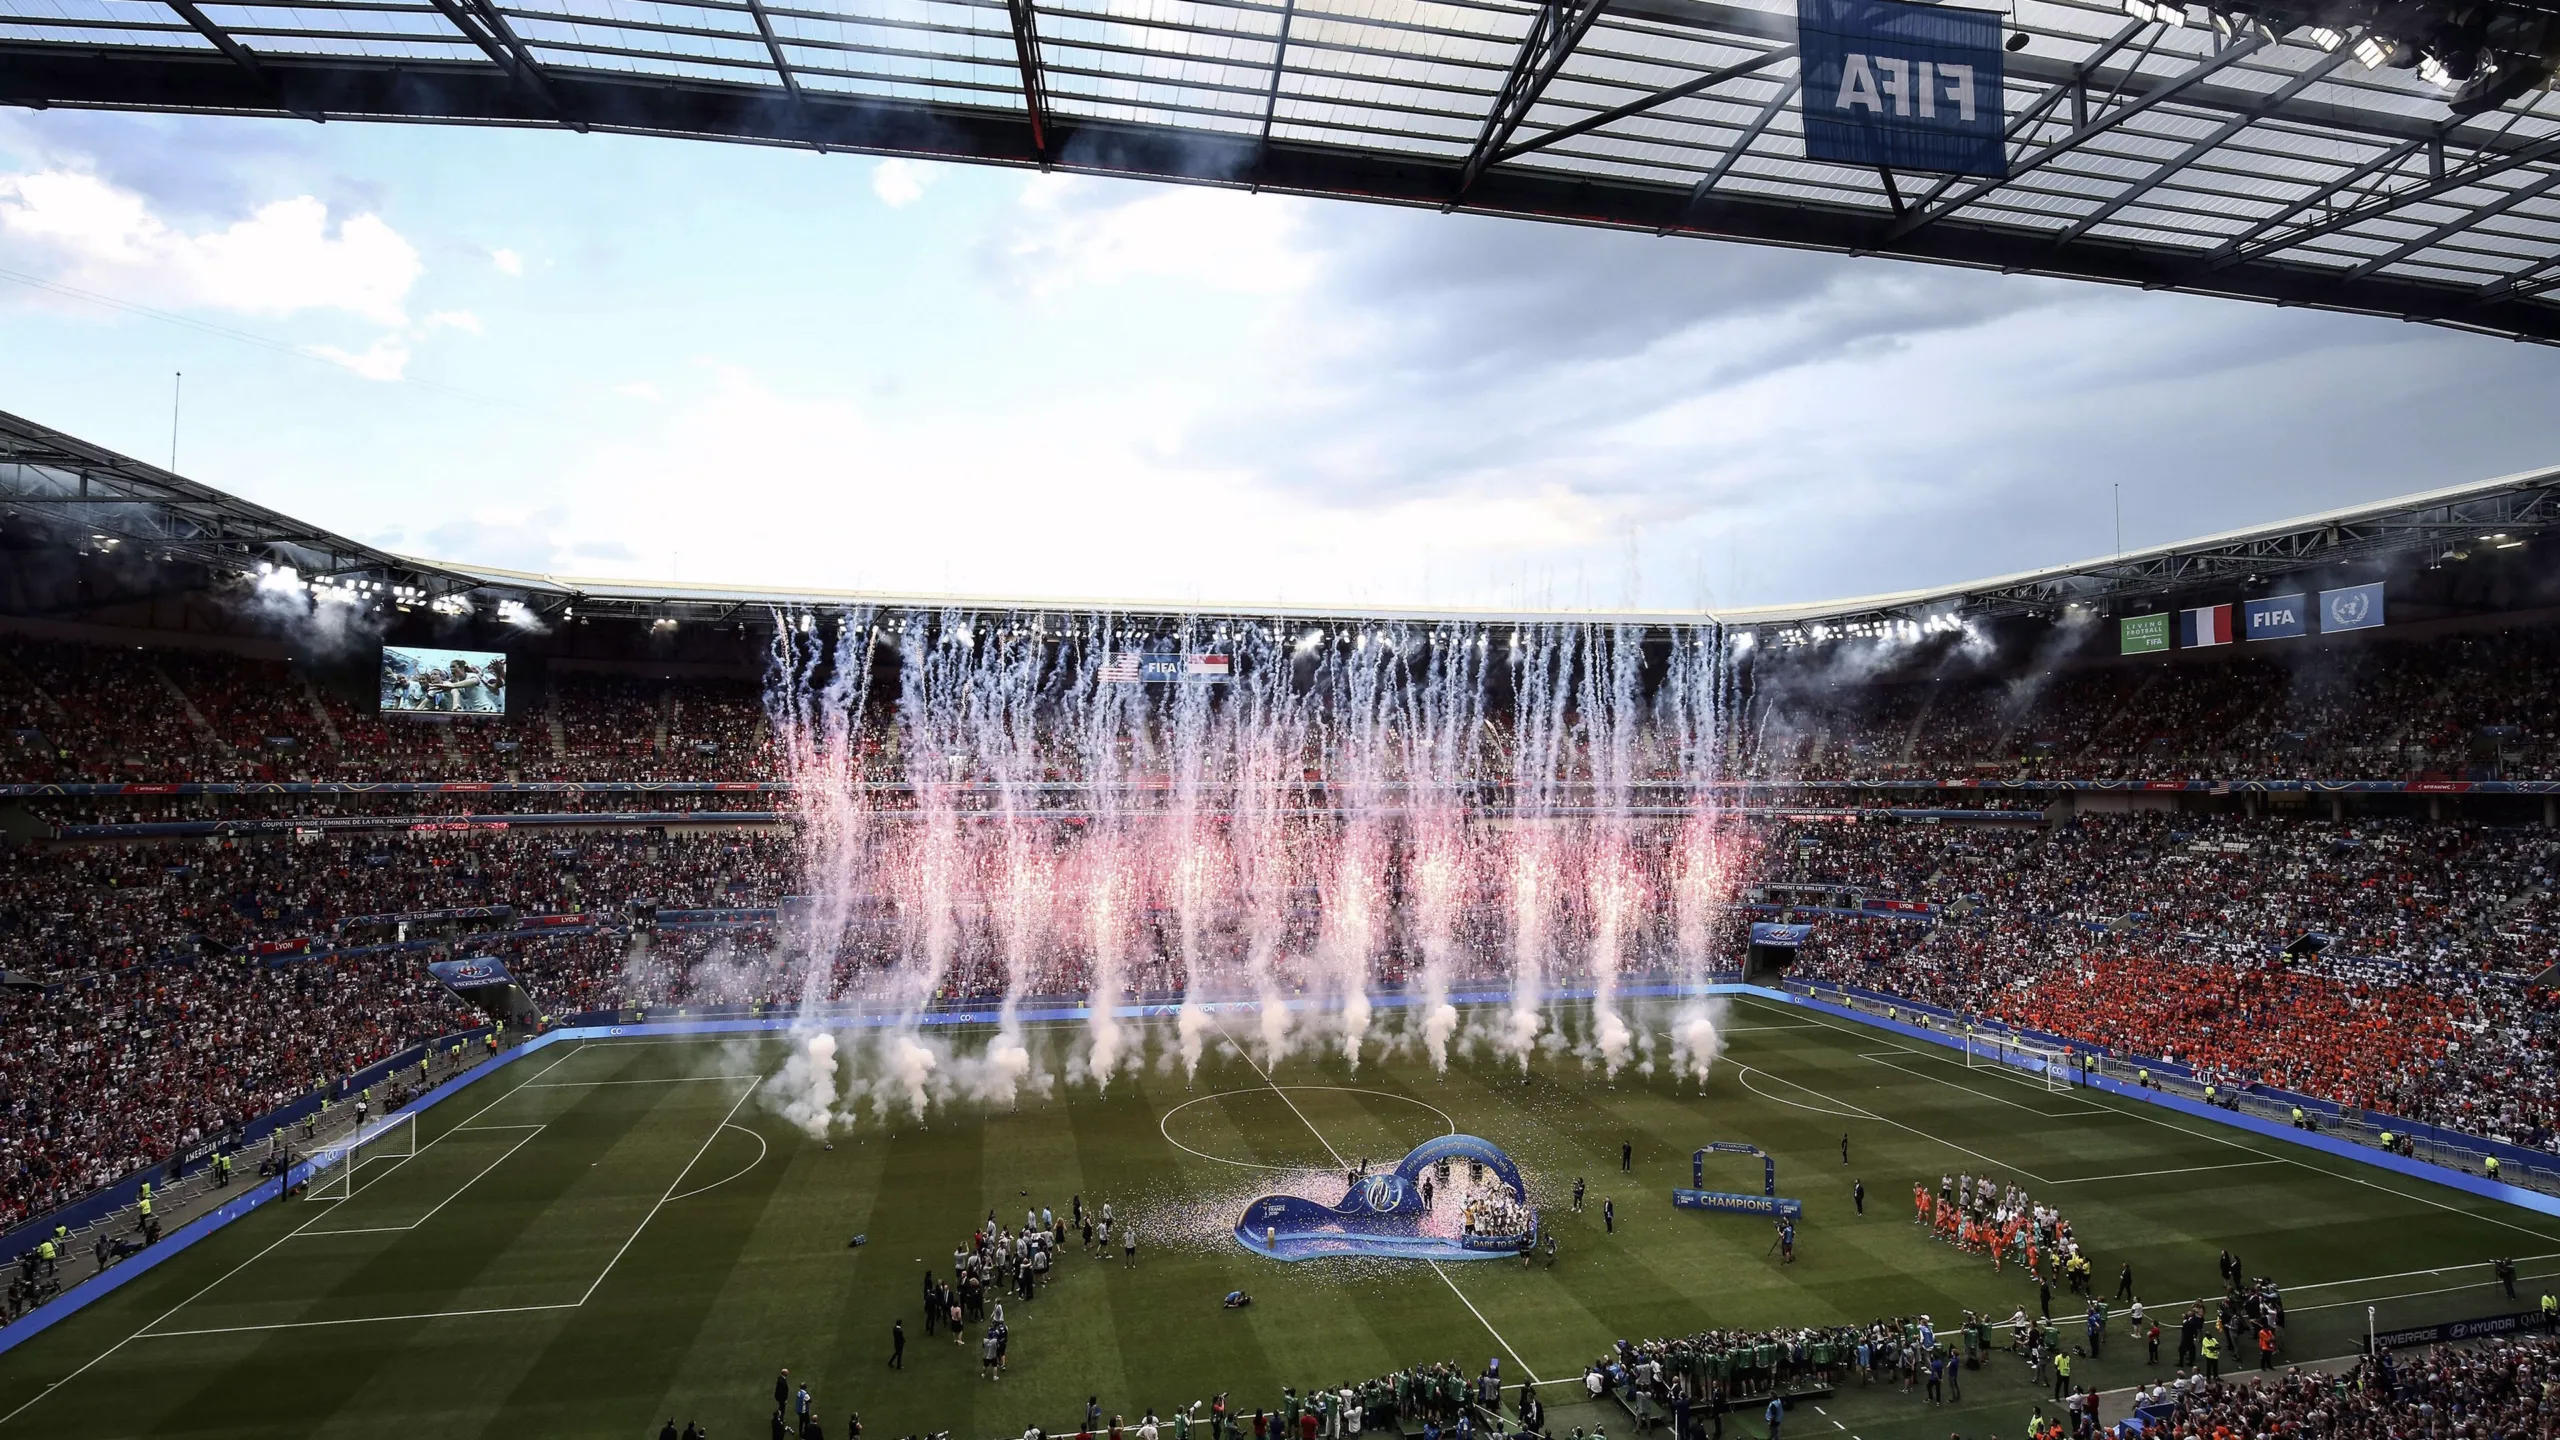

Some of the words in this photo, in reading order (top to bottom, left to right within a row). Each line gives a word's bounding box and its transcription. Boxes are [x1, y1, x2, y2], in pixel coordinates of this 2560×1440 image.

[2253, 609, 2296, 628] FIFA
[2126, 620, 2163, 630] LIVING
[2126, 627, 2163, 636] FOOTBALL
[2146, 638, 2163, 646] FIFA
[1148, 662, 1177, 673] FIFA
[275, 941, 293, 950] LYON
[184, 1141, 217, 1164] AMERICAN
[1700, 1195, 1773, 1211] CHAMPIONS
[1473, 1240, 1494, 1248] DARE
[2373, 1328, 2439, 1347] POWERADE
[2469, 1317, 2516, 1334] HYUNDAI
[2520, 1313, 2547, 1327] QATA
